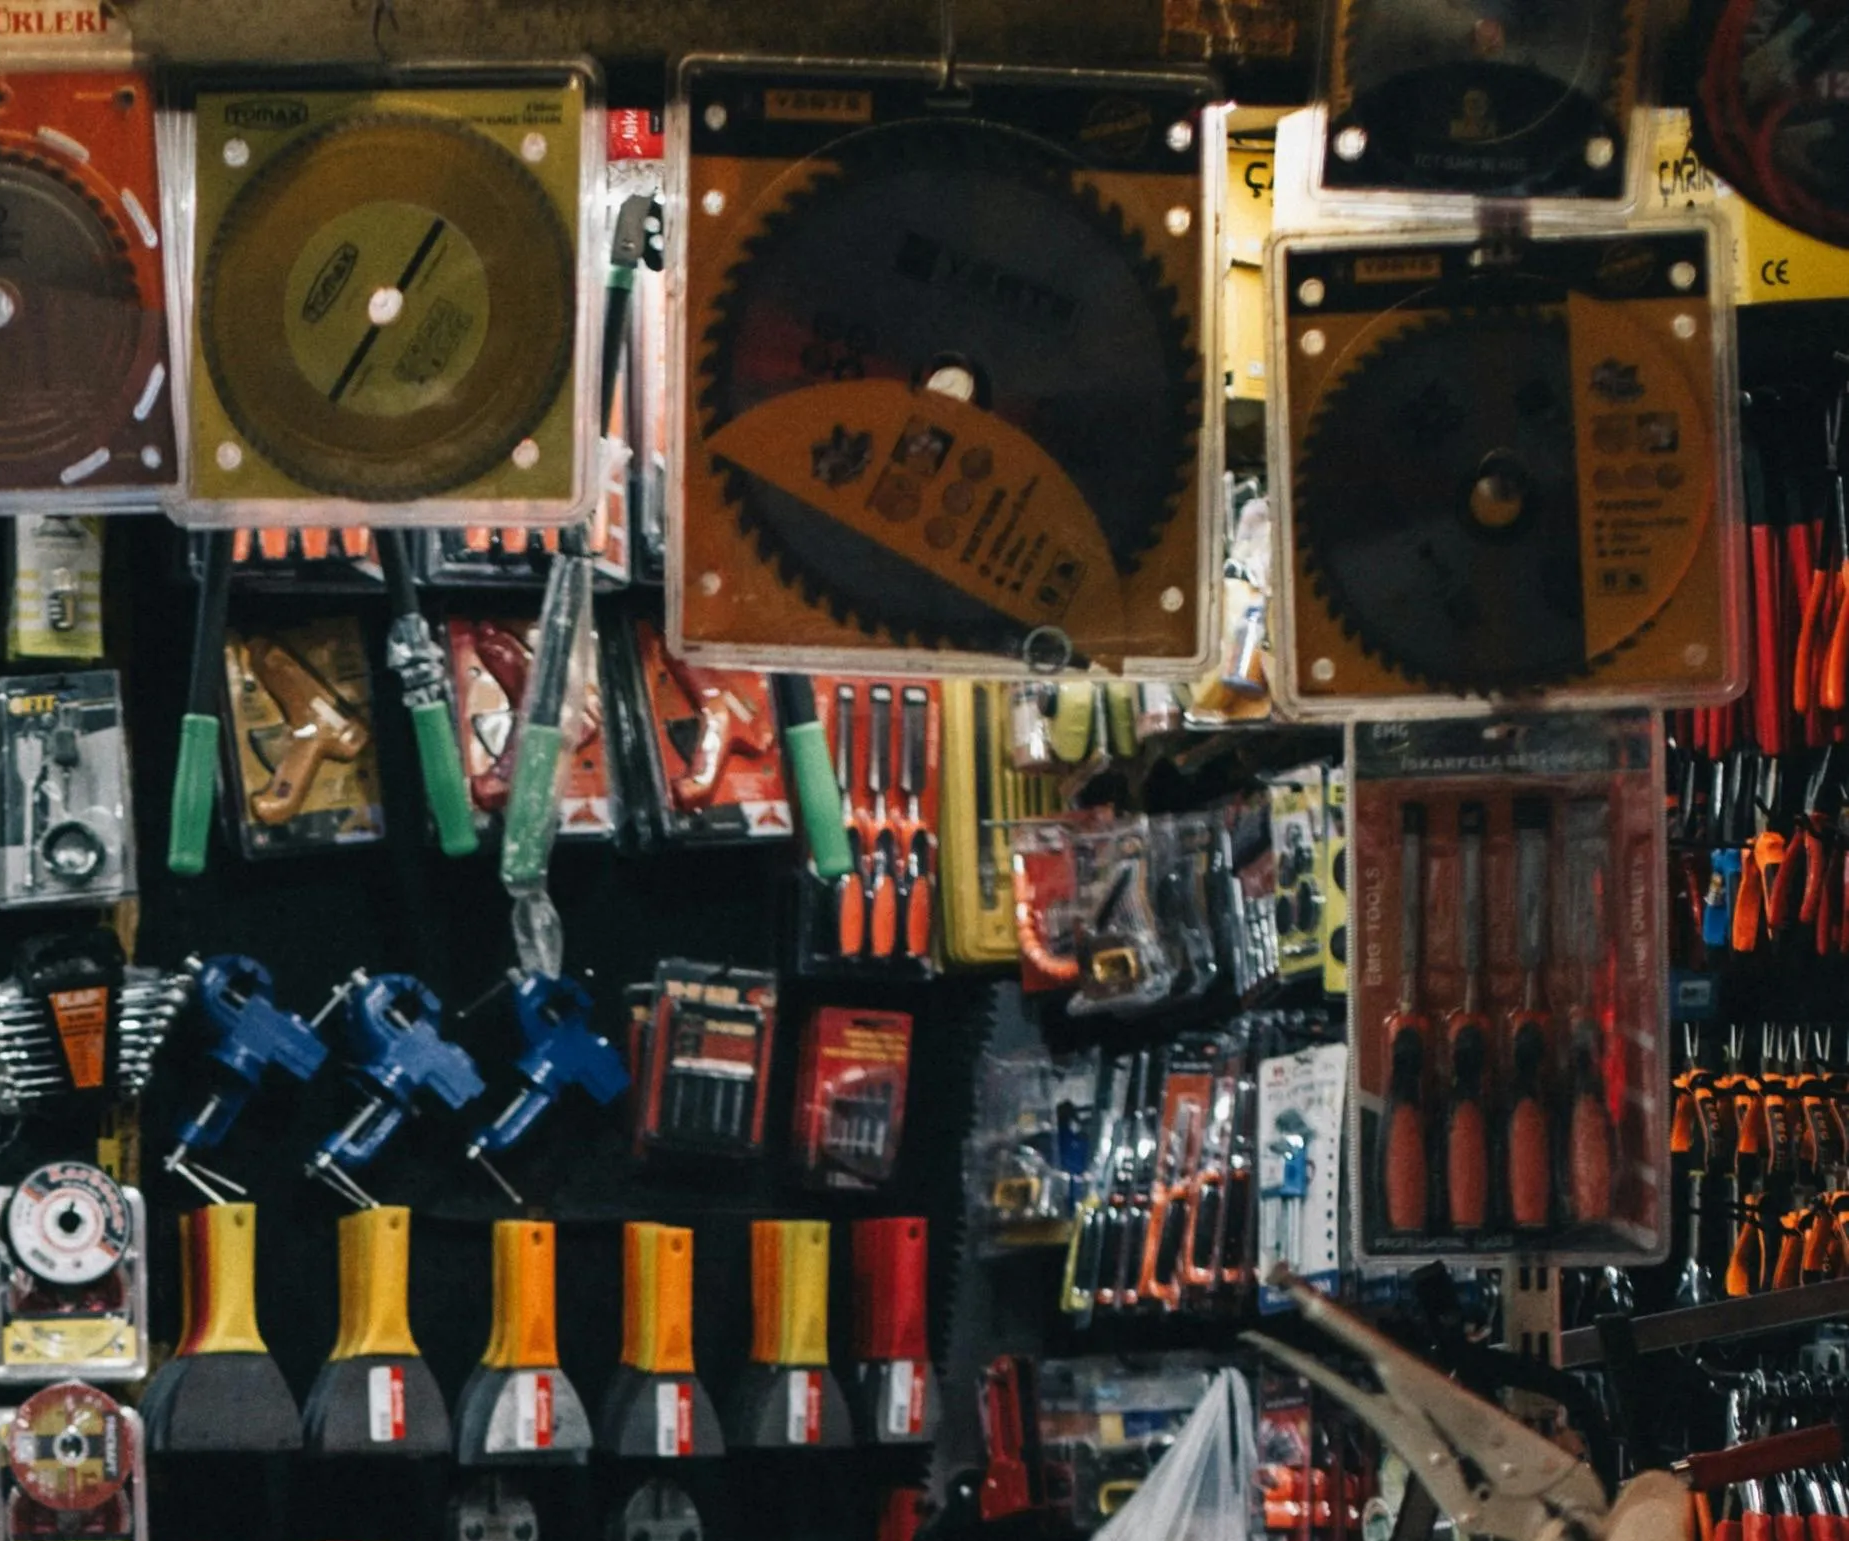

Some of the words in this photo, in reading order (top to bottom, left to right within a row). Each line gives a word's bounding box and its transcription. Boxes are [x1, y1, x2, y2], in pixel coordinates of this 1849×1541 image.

[228, 107, 306, 125] TOMAX
[1760, 259, 1791, 286] CE
[1365, 866, 1382, 930] TOOLS
